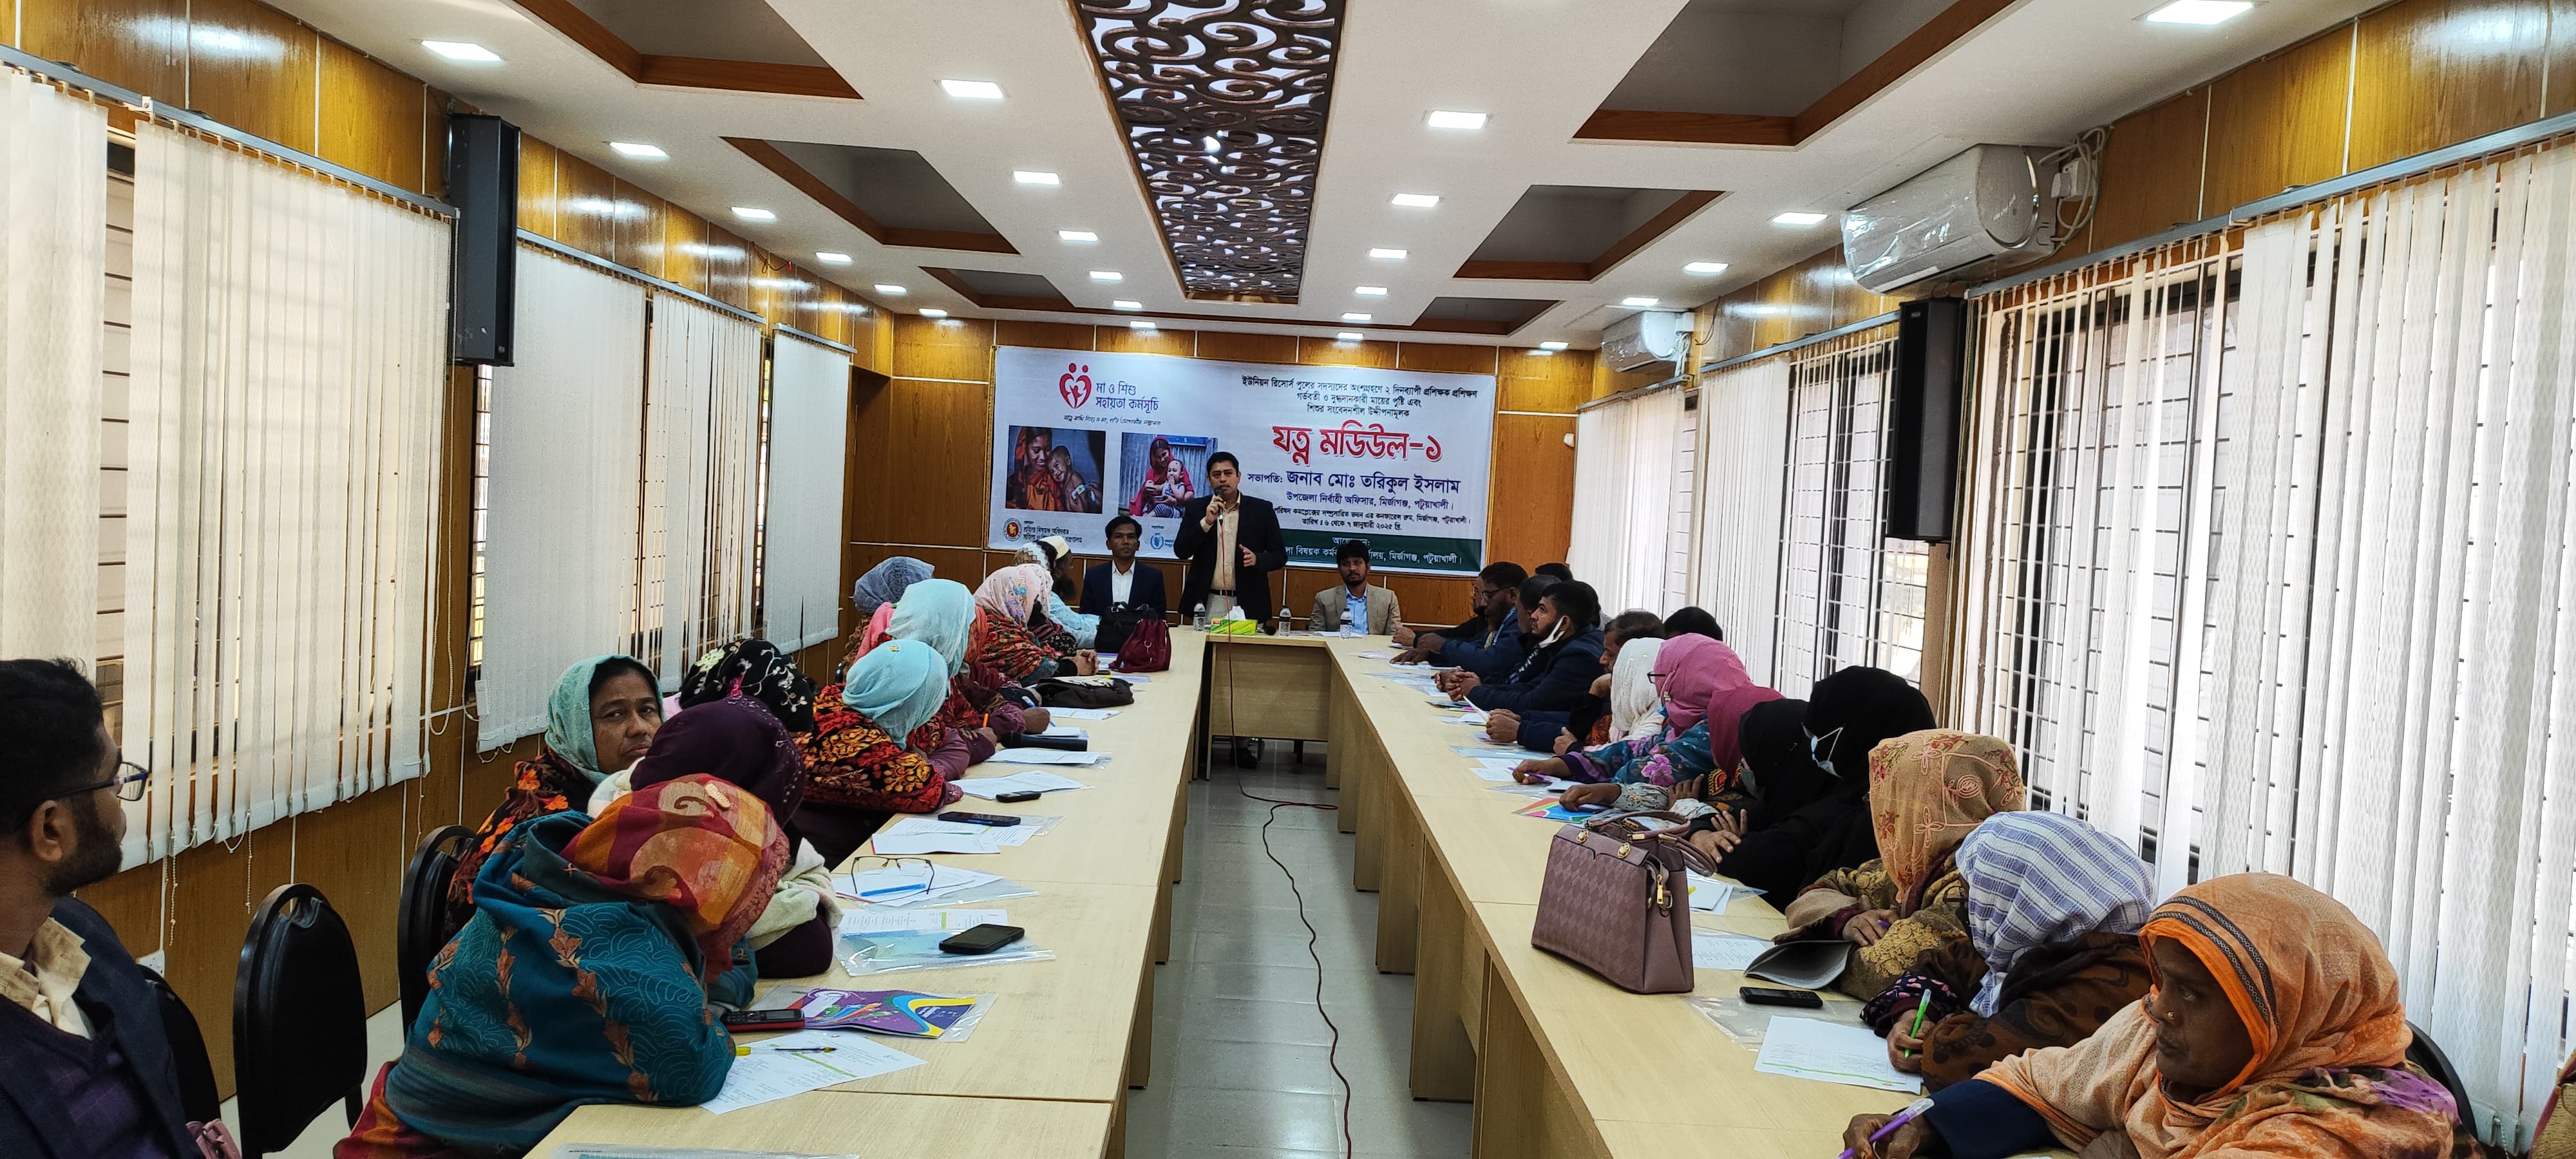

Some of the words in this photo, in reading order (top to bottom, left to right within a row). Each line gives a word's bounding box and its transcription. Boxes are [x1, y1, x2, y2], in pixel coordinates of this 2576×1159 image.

[1095, 381, 1106, 394] মা
[1108, 384, 1115, 394] ও
[1117, 381, 1136, 396] শিশু
[1242, 375, 1269, 387] ইউনিয়ন
[1385, 386, 1390, 395] ২
[1393, 384, 1422, 395] দিনব্যাপী
[1423, 386, 1450, 397] প্রশিক্ষক
[1452, 388, 1478, 399] প্রশিক্ষণ
[1095, 396, 1126, 410] সহায়তা
[1128, 396, 1160, 413] কর্মসূচি
[1296, 390, 1321, 401] গর্ভবতী
[1370, 396, 1390, 406] মায়ের
[1407, 399, 1422, 408] এবং
[1307, 402, 1324, 413] শিশুর
[1272, 426, 1312, 467] যত্ন
[1319, 419, 1444, 463] মডিউল-১
[1286, 470, 1324, 487] জনাব
[1328, 473, 1356, 489] মোঃ
[1360, 471, 1410, 495] তরিকুল
[1413, 475, 1461, 495] ইসলাম
[1286, 491, 1318, 503] উপজেলা
[1320, 492, 1343, 504] নির্বাহী
[1345, 494, 1377, 507] অফিসার,
[1379, 495, 1411, 509] মির্জাগঞ্জ,
[1295, 545, 1320, 556] বিষয়ক
[1388, 549, 1420, 563] মির্জাগঞ্জ,
